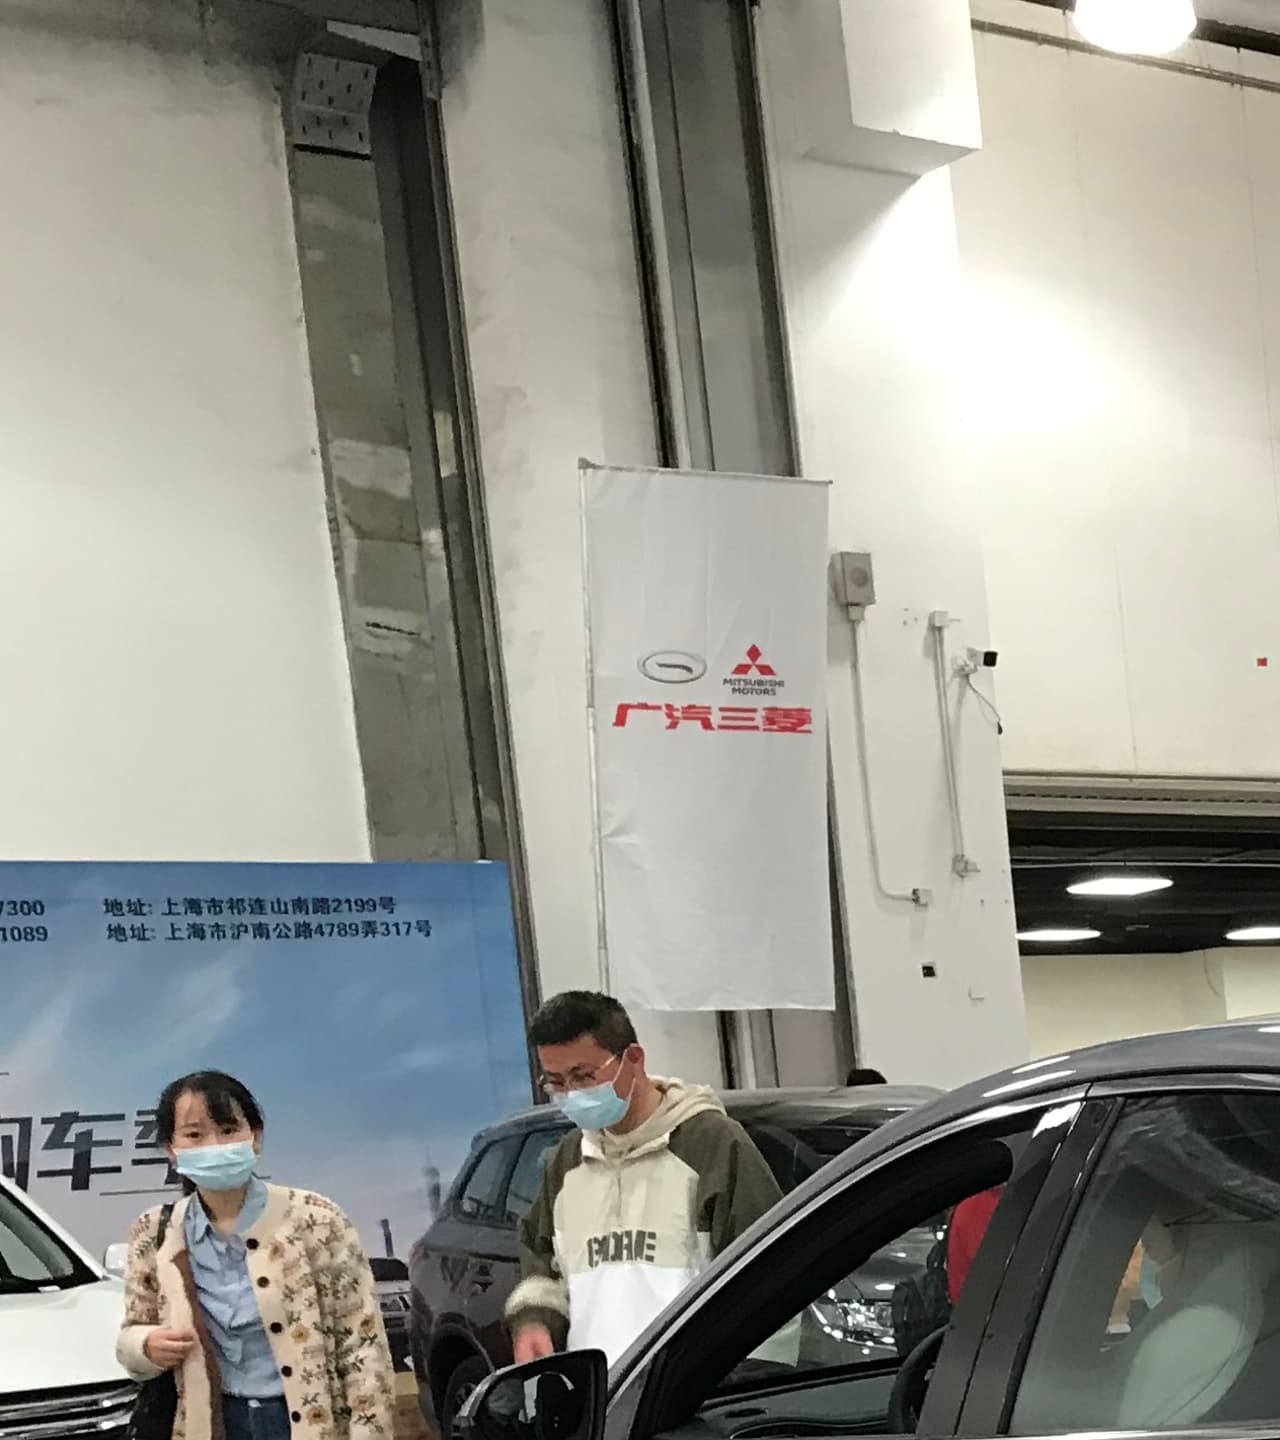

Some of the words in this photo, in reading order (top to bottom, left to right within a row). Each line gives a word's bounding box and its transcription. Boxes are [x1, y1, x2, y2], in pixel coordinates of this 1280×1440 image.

[722, 678, 785, 688] MITSUBISHI
[731, 687, 777, 696] MOTORS
[612, 702, 813, 734] 广汽三菱
[161, 896, 396, 917] 上海市祁连山南路2199号
[164, 919, 433, 941] 上海市沪南公路4789弄317号
